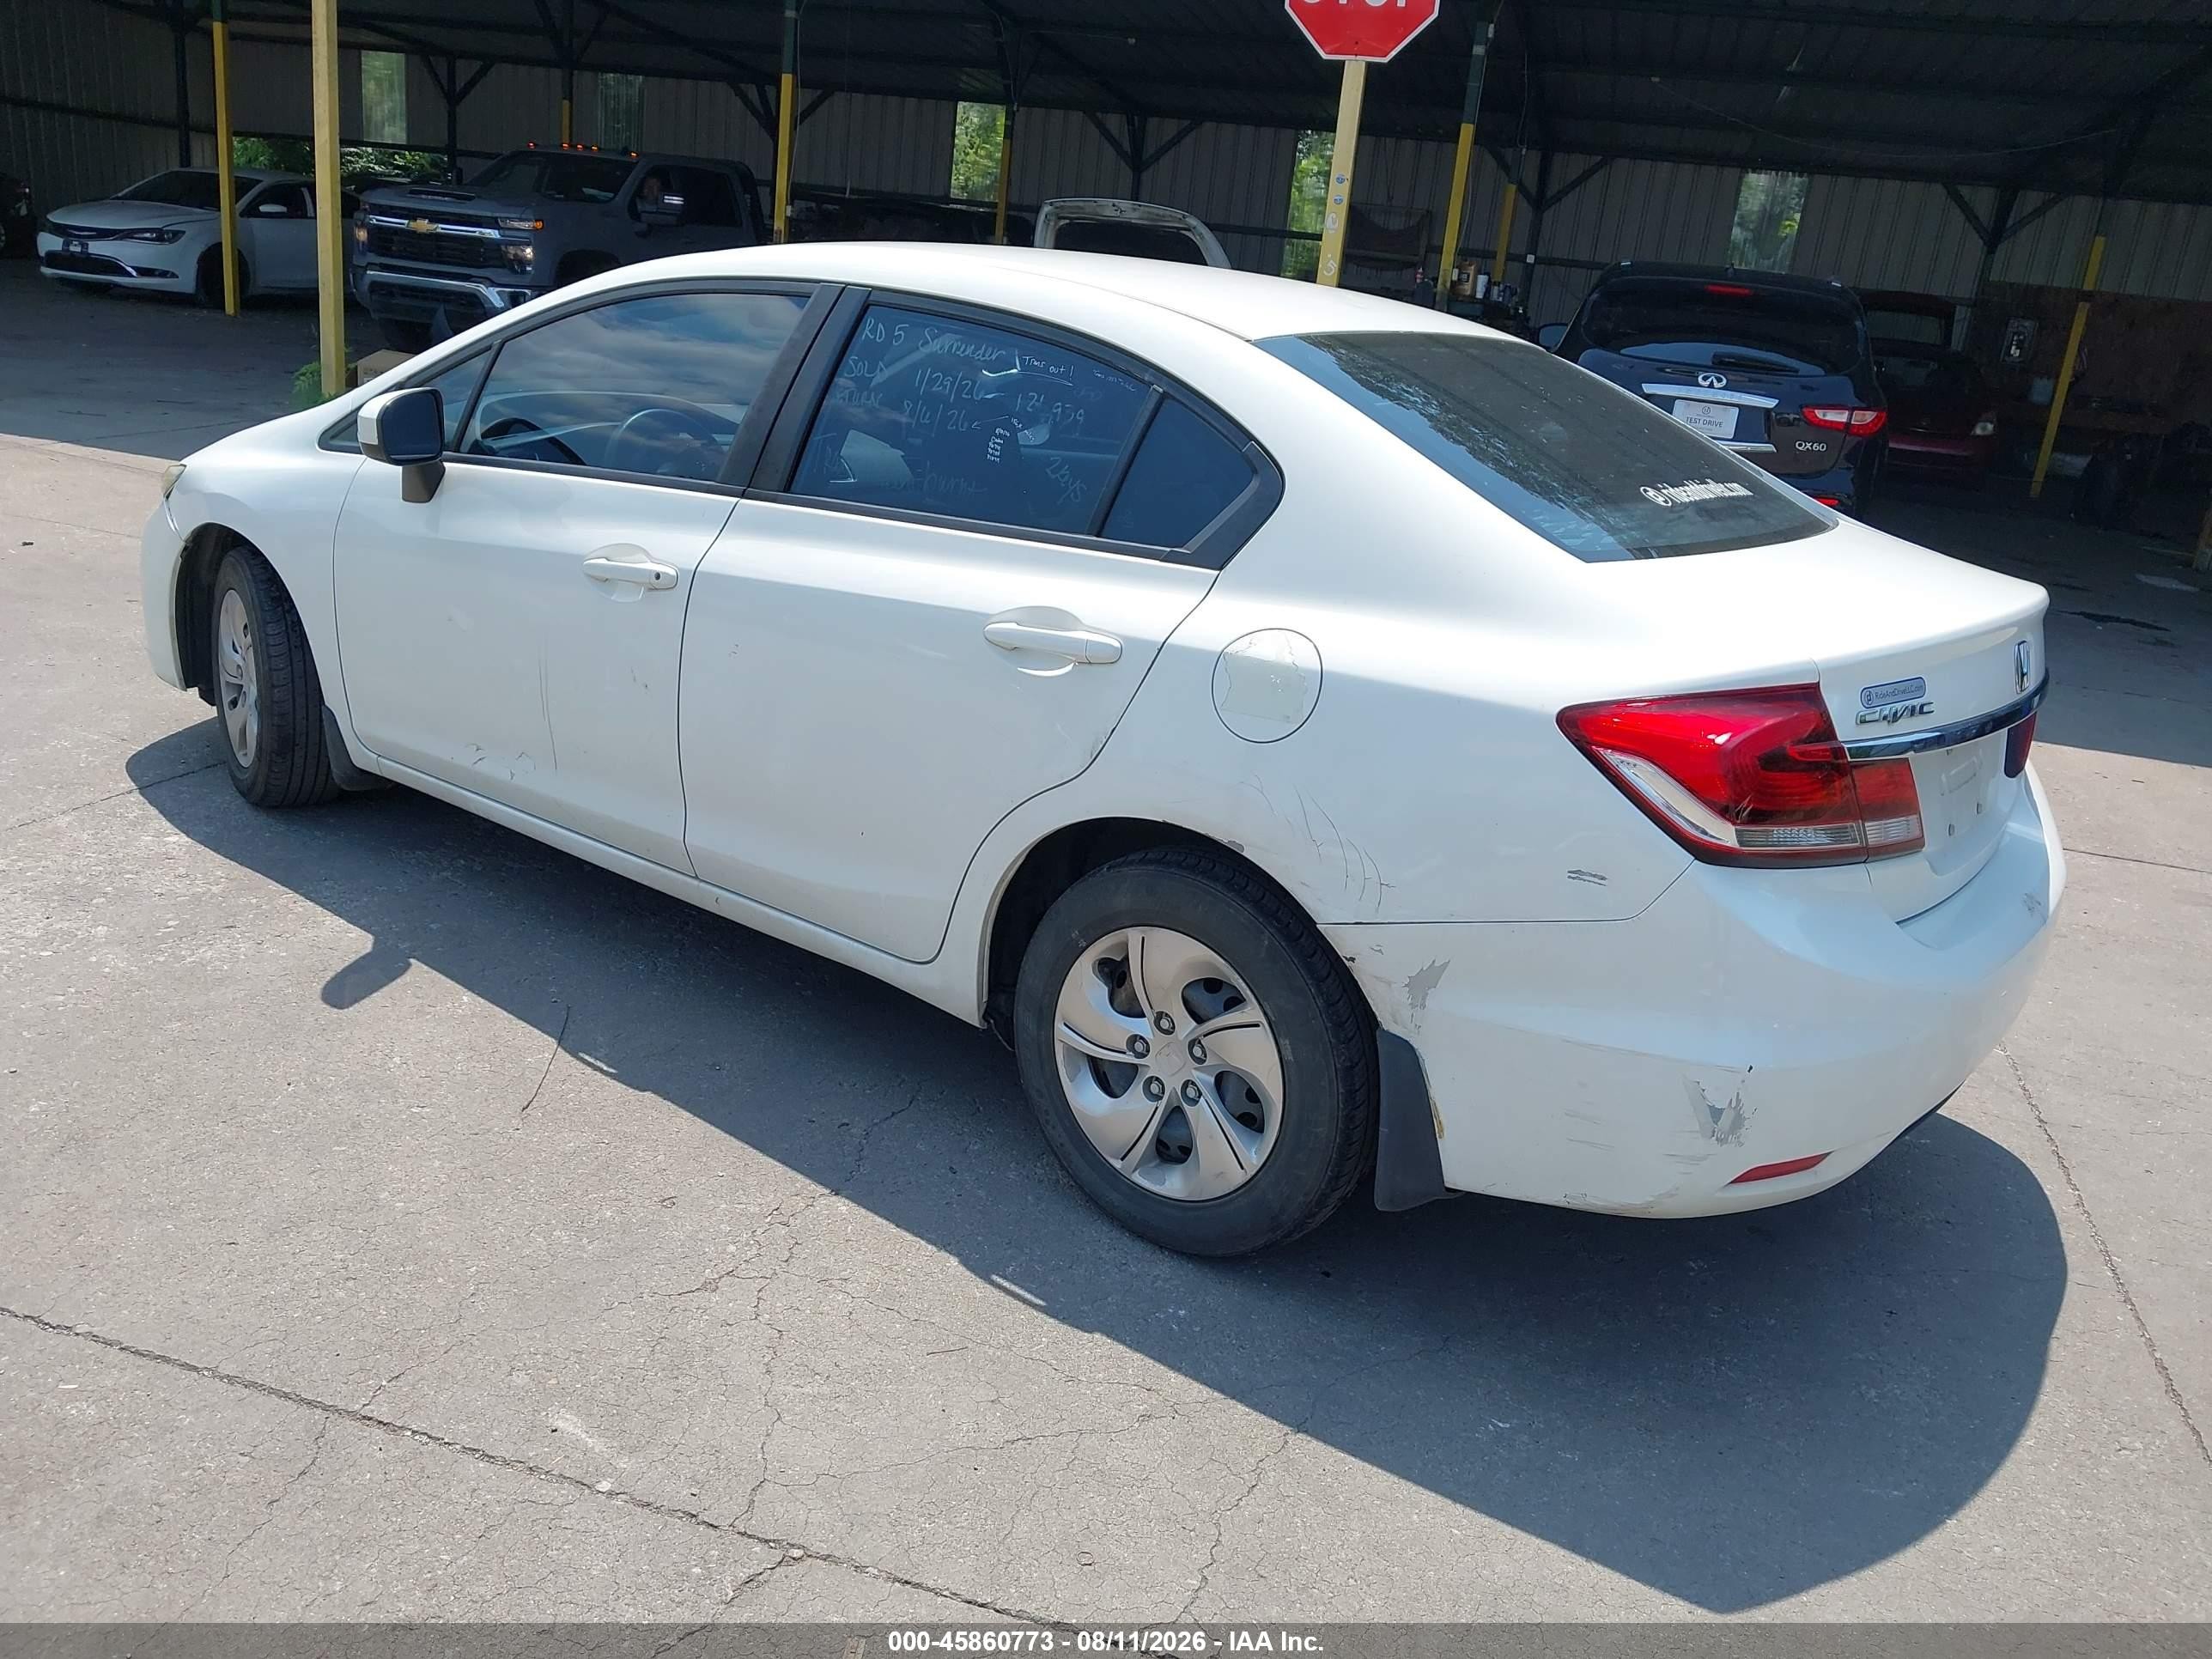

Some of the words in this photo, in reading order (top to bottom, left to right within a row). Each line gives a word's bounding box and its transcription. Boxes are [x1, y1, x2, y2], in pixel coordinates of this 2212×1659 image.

[861, 316, 886, 343] RD
[892, 323, 910, 346] 5
[918, 326, 1007, 361] Surrender
[844, 356, 888, 379] SOLD
[1686, 416, 1701, 425] TEST
[1702, 418, 1724, 428] DRIVE
[1795, 440, 1827, 453] QX60
[1856, 701, 1936, 726] CIVIC
